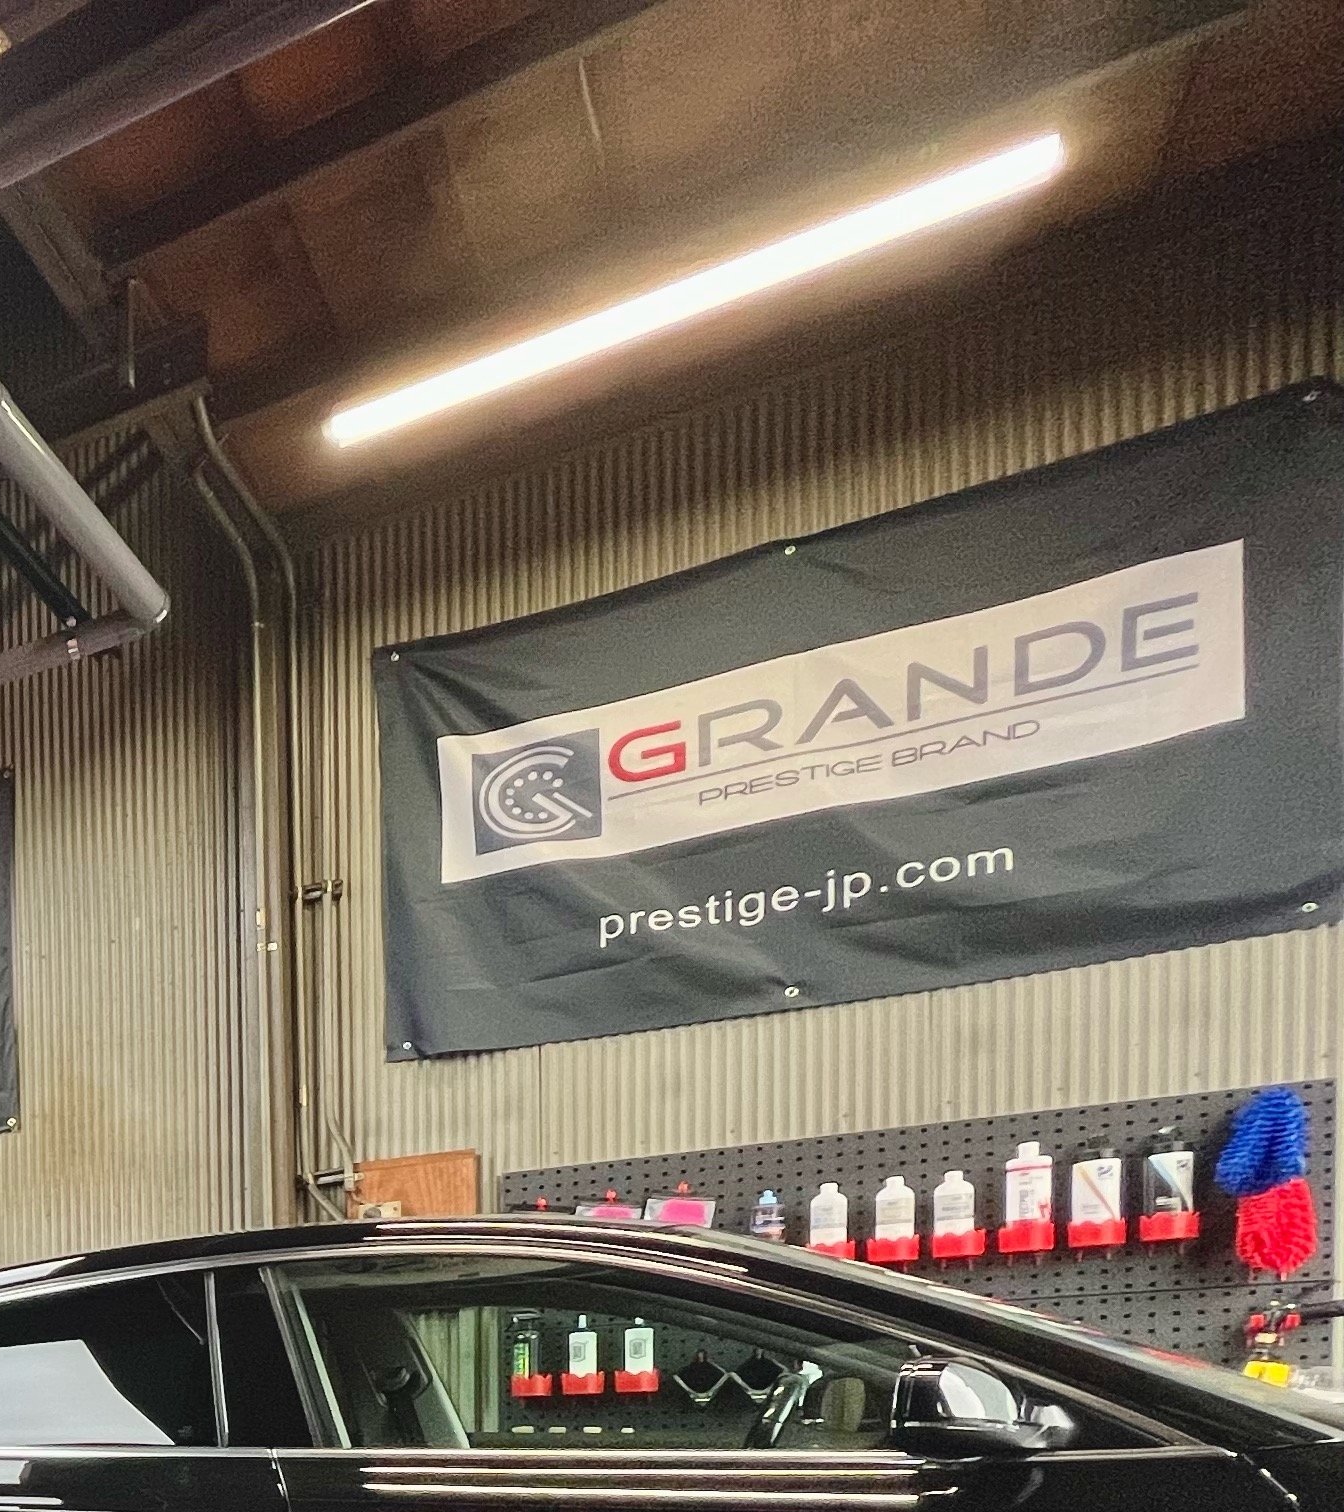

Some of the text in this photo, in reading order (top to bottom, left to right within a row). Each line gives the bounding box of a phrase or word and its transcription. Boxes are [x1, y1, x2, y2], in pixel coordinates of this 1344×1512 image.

[607, 591, 1199, 784] GRANDE
[698, 719, 1041, 806] PRESTIGE BRAND
[598, 846, 1013, 948] prestige-jp.com
